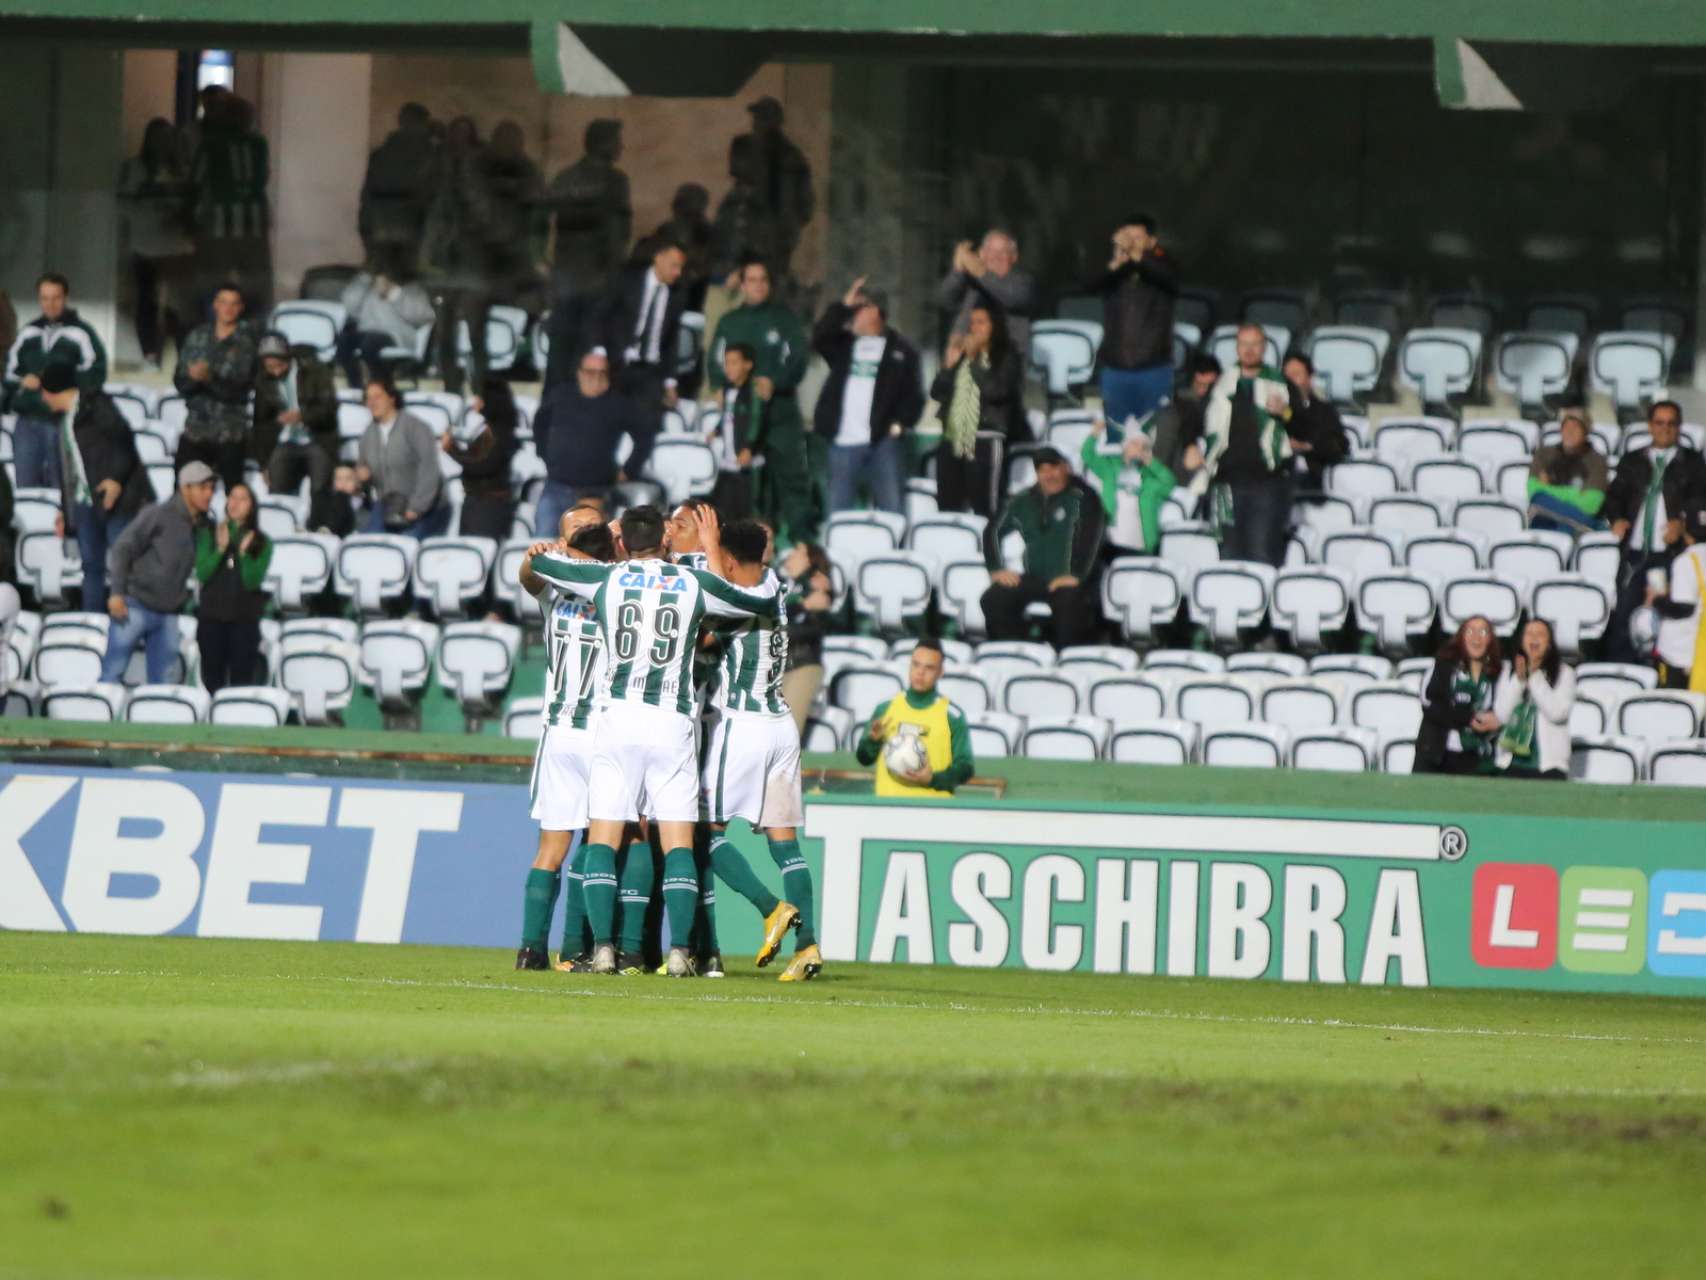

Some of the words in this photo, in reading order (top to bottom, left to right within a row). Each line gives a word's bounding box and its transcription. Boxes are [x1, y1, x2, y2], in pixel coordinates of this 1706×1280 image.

[618, 573, 688, 593] CAIXA
[553, 630, 603, 699] 77
[614, 600, 681, 667] 89
[804, 804, 1430, 987] TASCHIBRA
